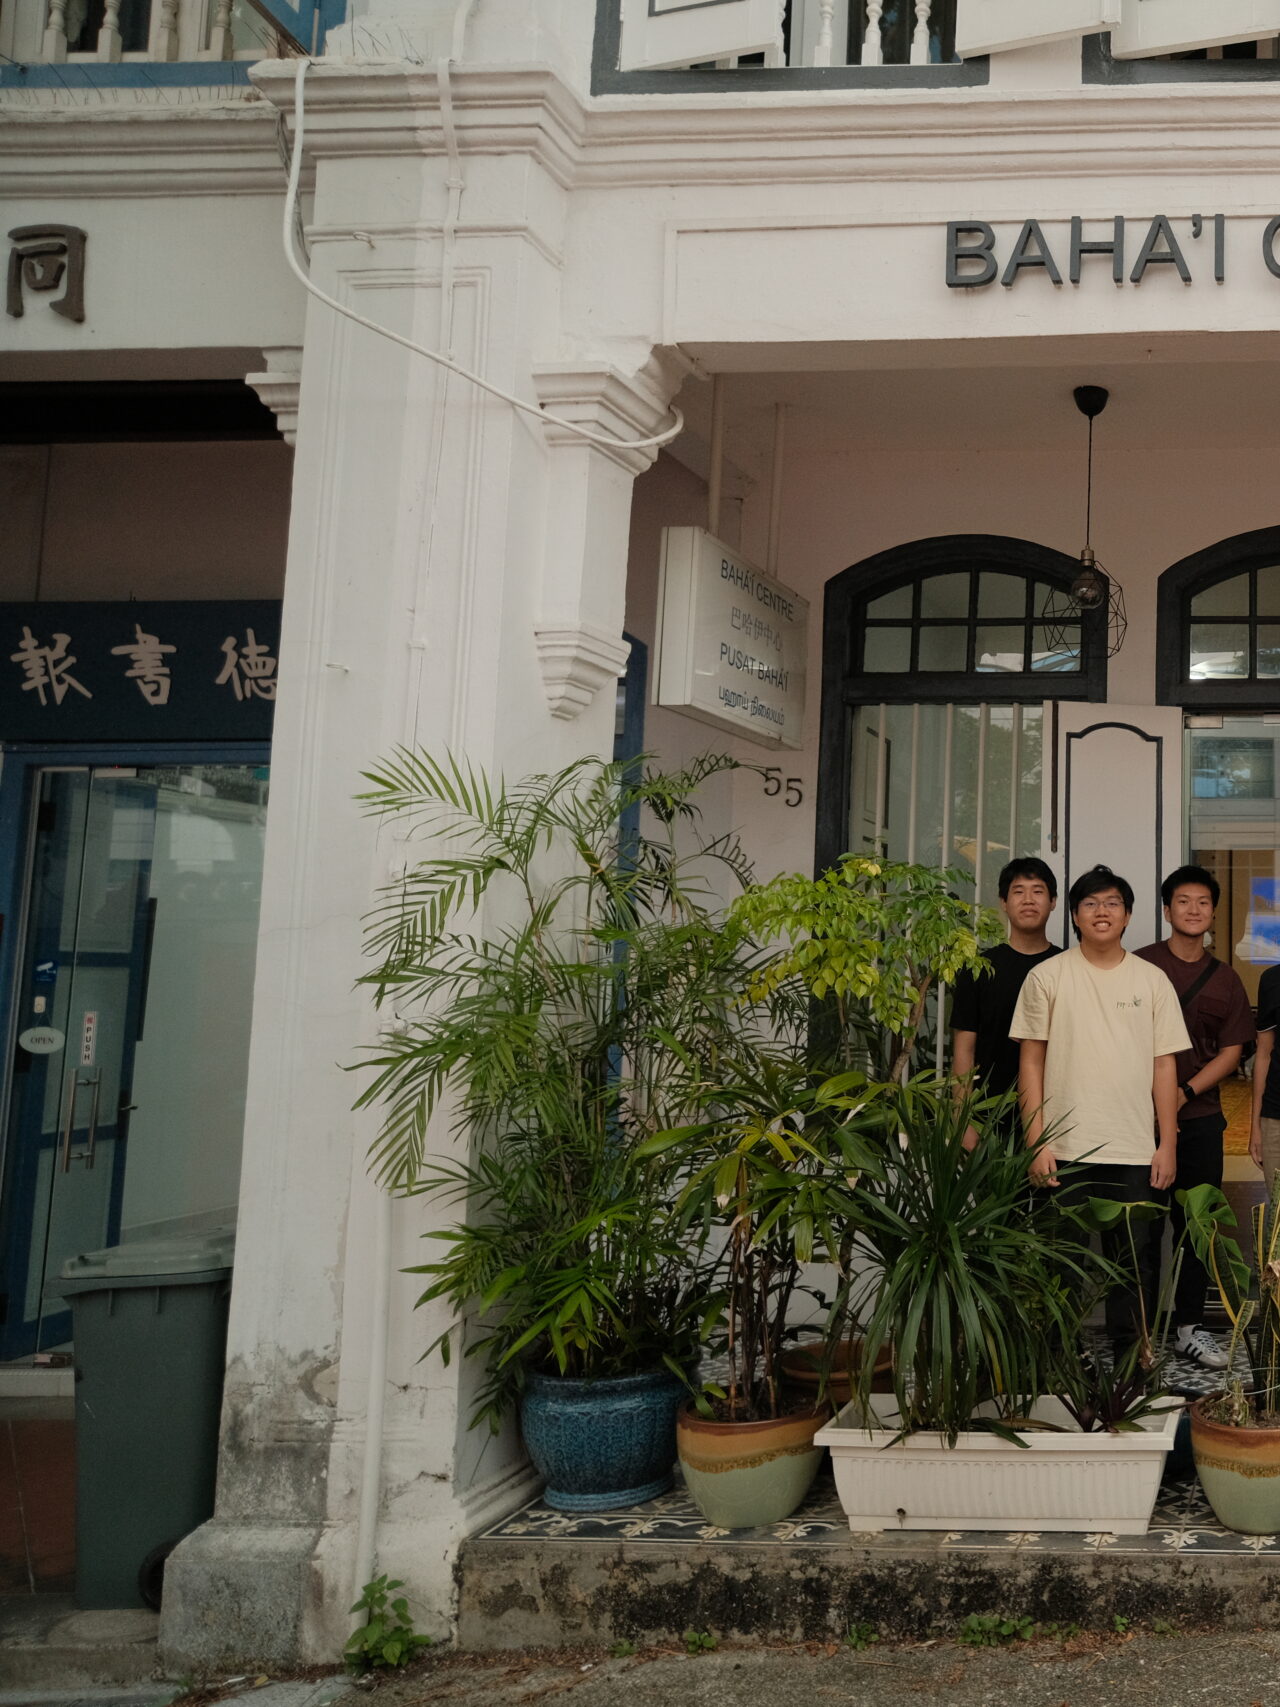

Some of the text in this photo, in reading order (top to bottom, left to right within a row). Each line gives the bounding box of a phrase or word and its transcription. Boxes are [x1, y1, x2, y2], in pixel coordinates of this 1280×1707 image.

[945, 212, 1226, 289] BAHA'I
[756, 582, 795, 623] CENTRE
[731, 606, 784, 652] 巴哈伊中心
[719, 641, 756, 676] PUSAT
[763, 766, 803, 808] 55
[30, 1036, 54, 1045] OPEN
[84, 1026, 92, 1060] PUSH
